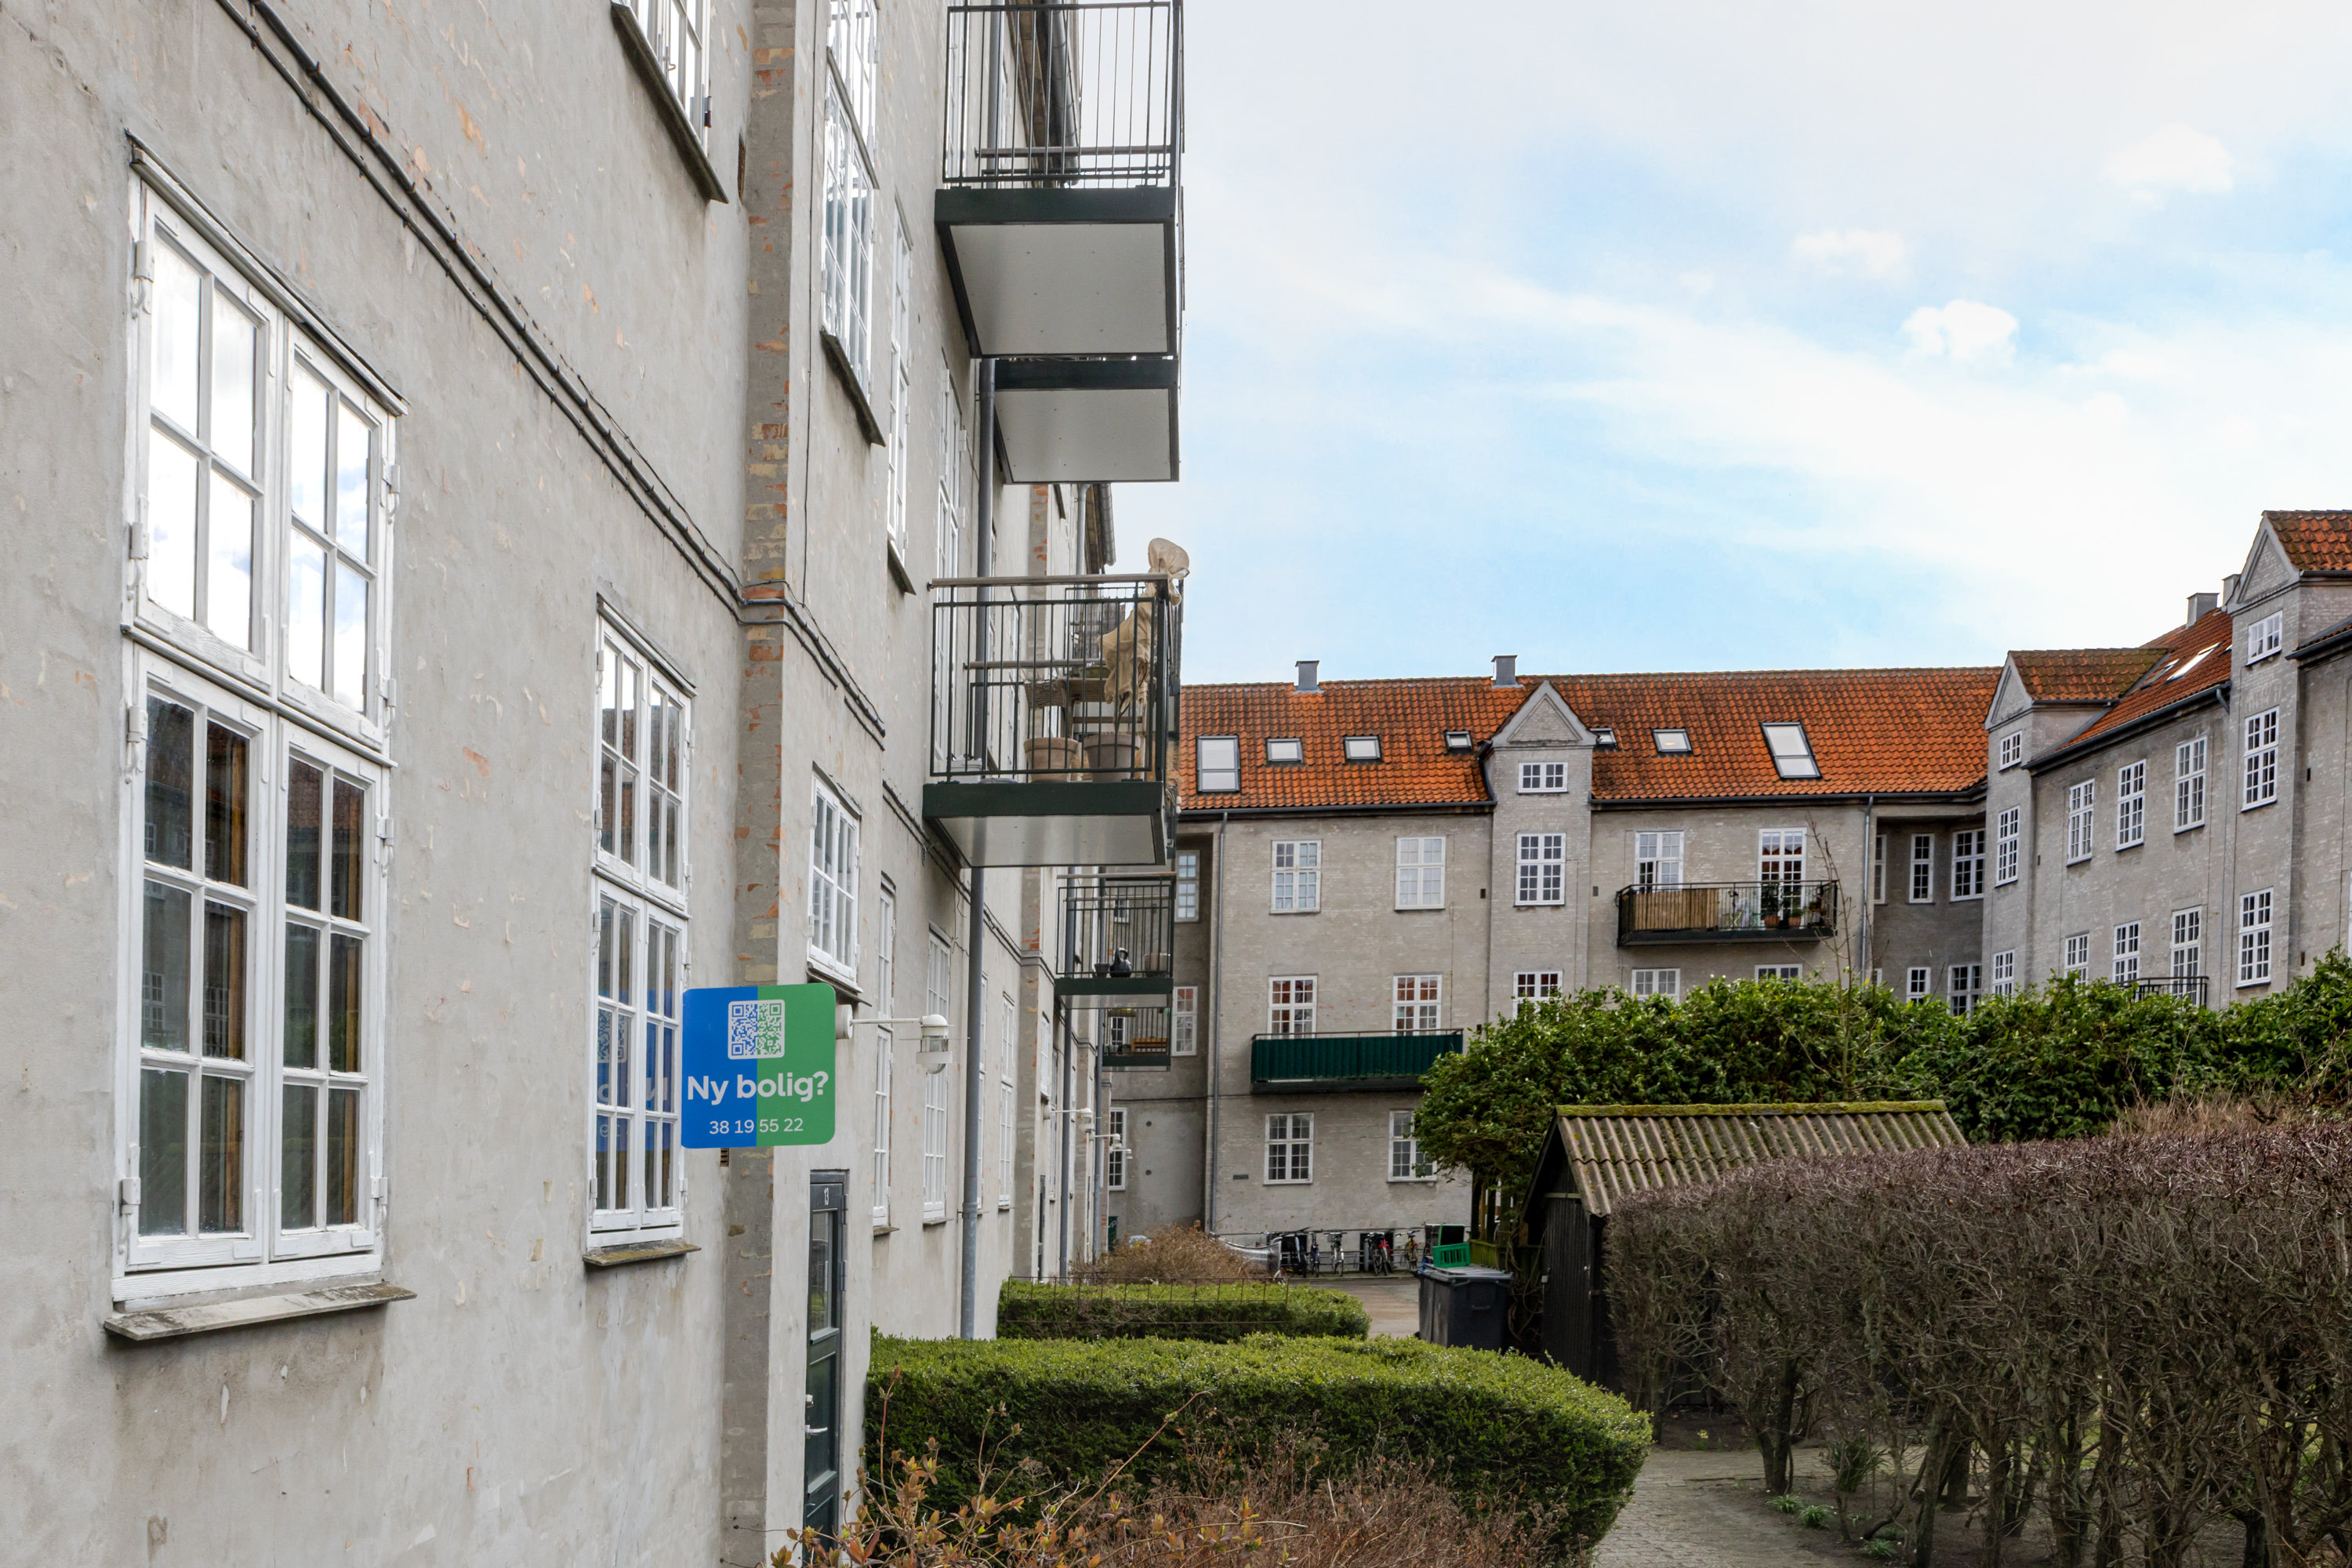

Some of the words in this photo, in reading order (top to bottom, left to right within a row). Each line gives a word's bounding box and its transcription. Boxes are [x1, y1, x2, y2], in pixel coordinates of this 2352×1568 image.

[688, 1076, 729, 1105] Ny
[737, 1071, 829, 1102] bolig?
[709, 1121, 730, 1134] 38
[735, 1120, 754, 1134] 19
[759, 1119, 779, 1132] 55
[784, 1118, 804, 1131] 22
